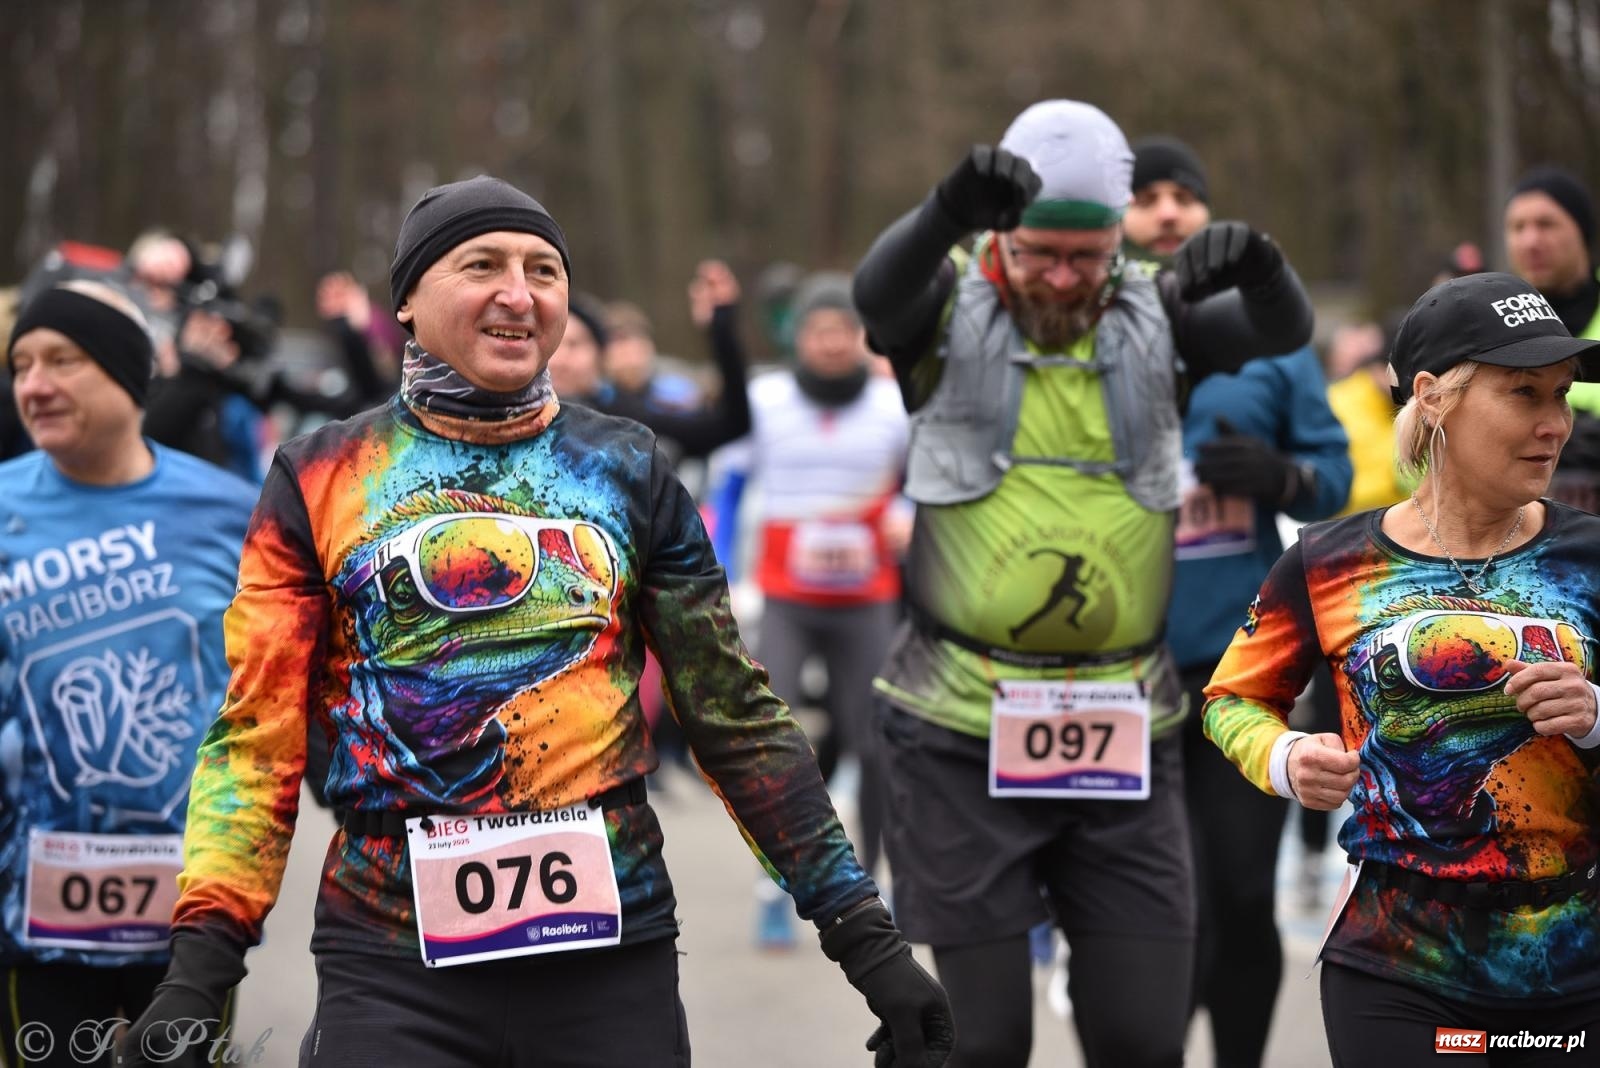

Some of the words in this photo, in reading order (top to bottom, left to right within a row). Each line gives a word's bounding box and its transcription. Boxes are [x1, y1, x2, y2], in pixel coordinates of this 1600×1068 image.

[1503, 306, 1564, 328] CHALL
[0, 520, 157, 607] MORSY
[4, 562, 181, 647] RACIBÓRZ
[1025, 721, 1114, 761] 097
[427, 818, 468, 838] BIEG
[474, 807, 588, 832] Twardziela
[61, 872, 158, 916] 067
[455, 851, 577, 915] 076
[542, 923, 588, 937] Racibórz
